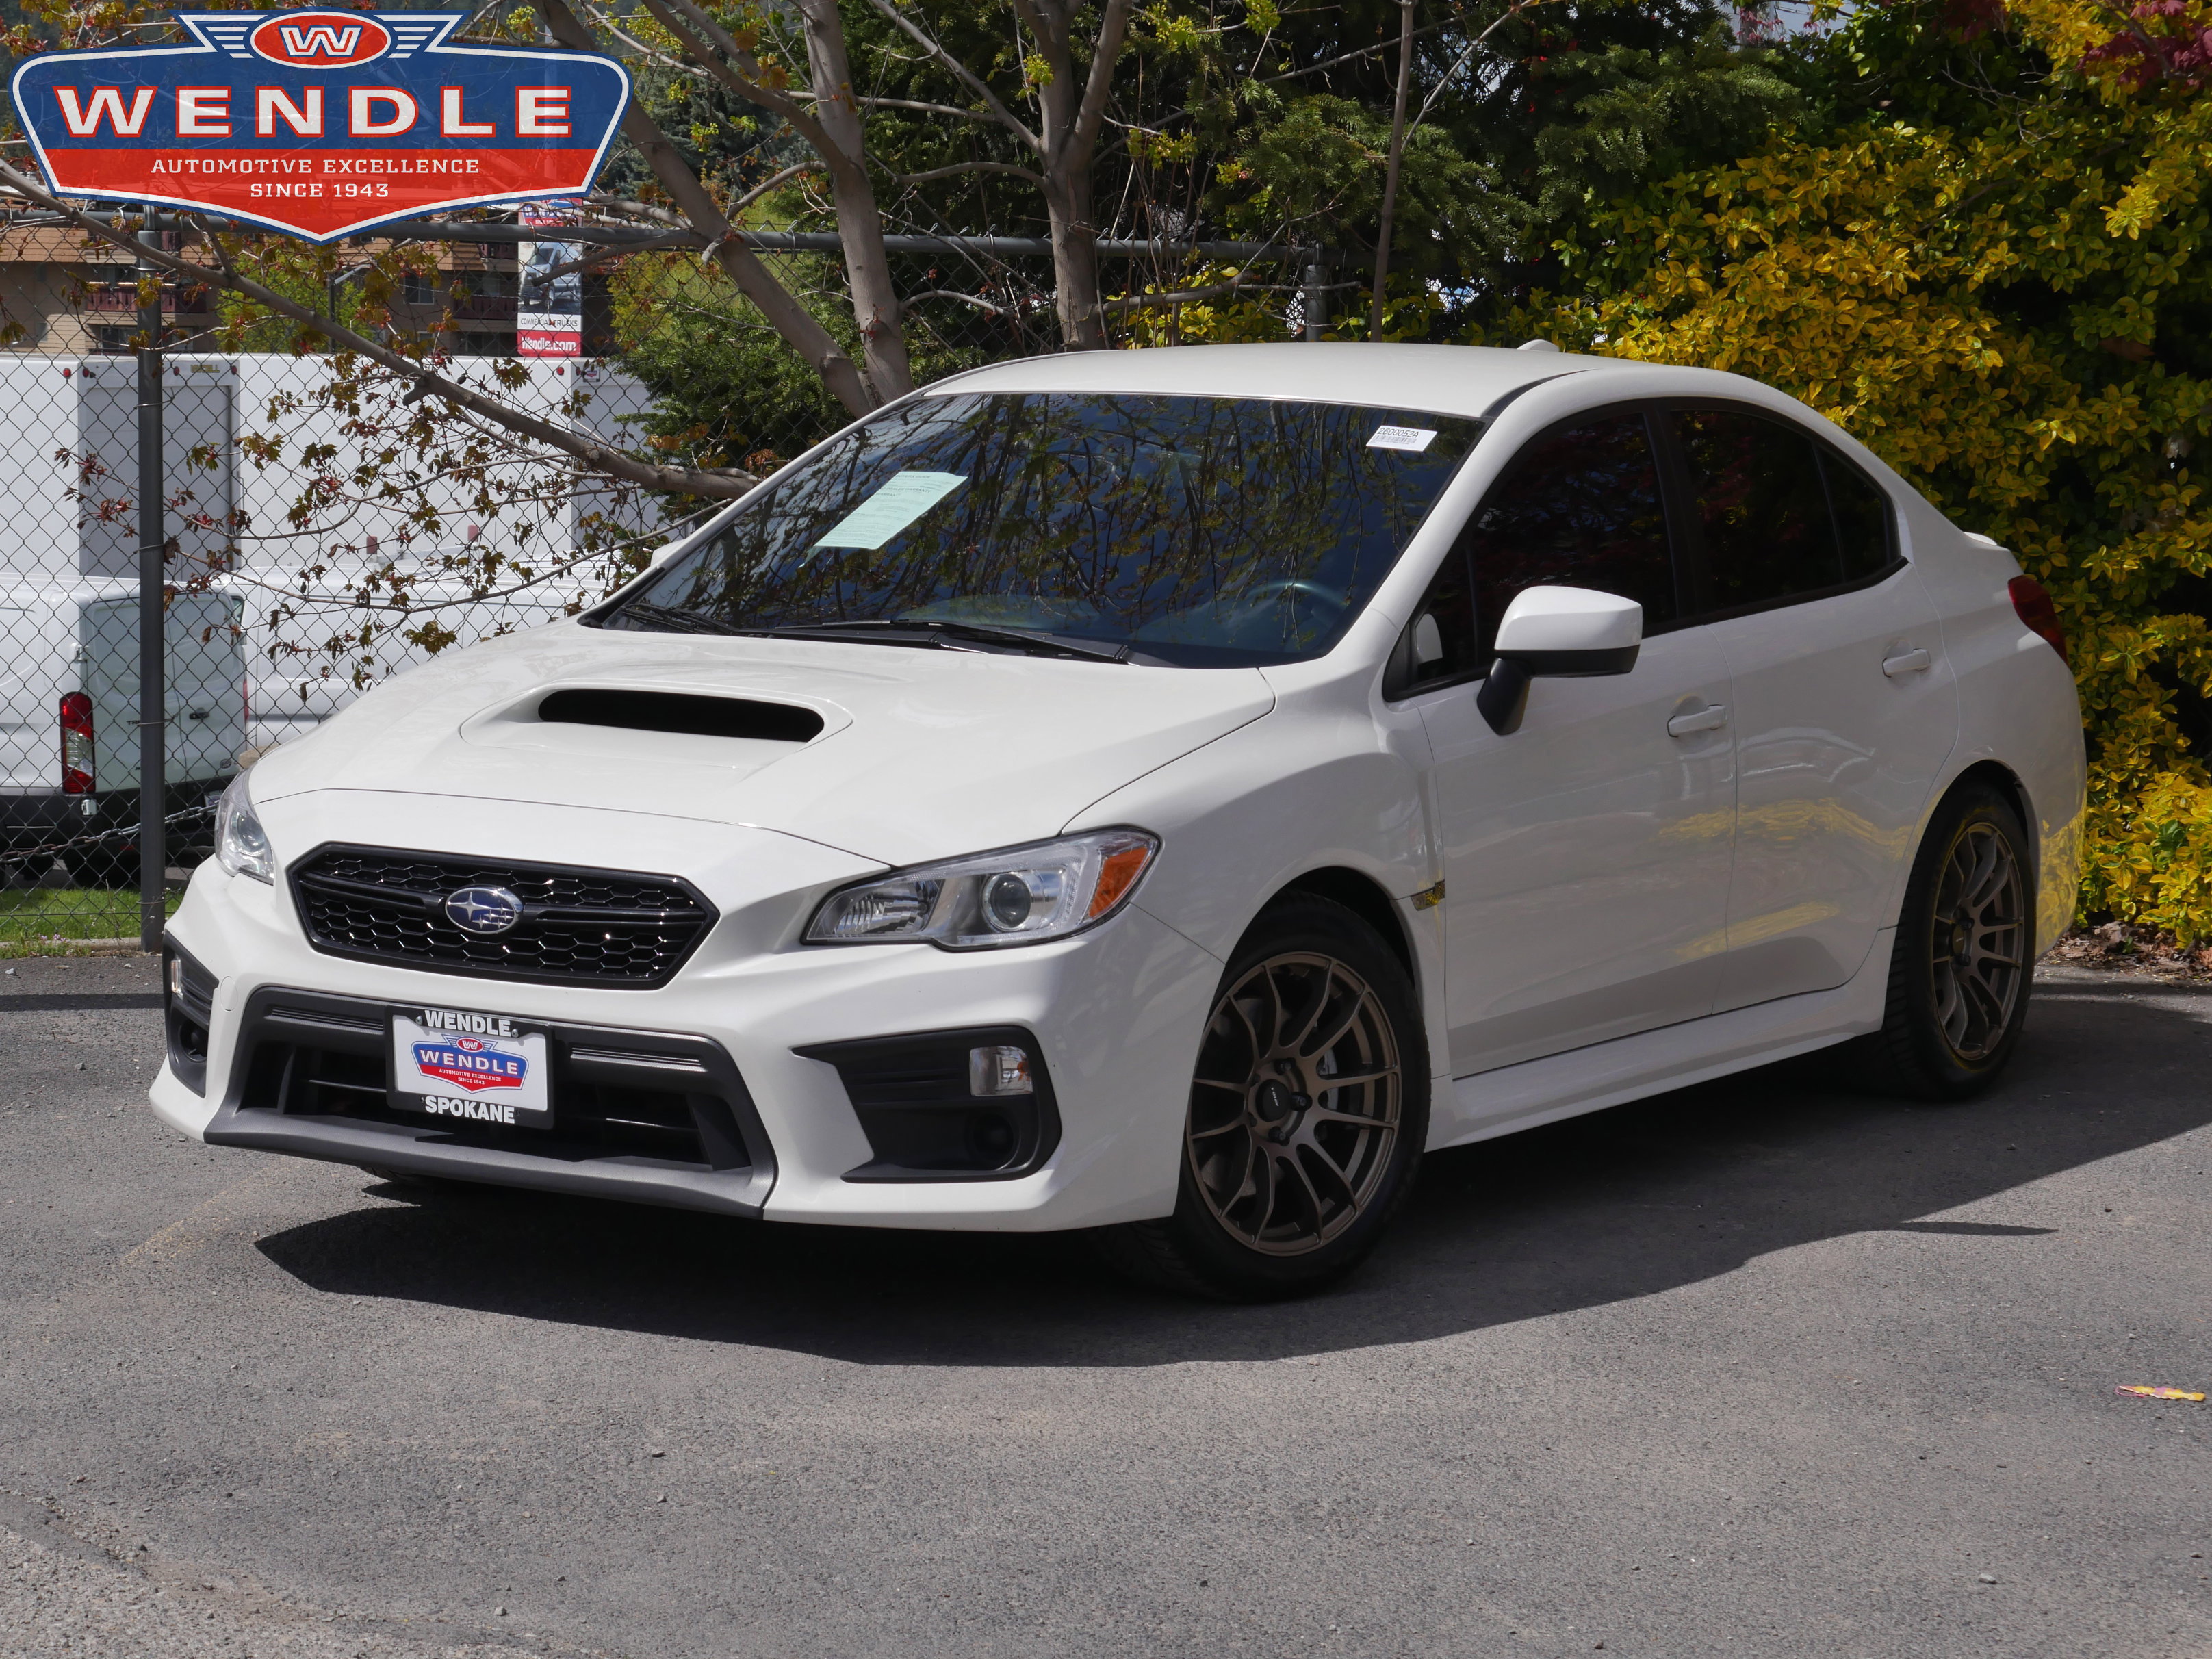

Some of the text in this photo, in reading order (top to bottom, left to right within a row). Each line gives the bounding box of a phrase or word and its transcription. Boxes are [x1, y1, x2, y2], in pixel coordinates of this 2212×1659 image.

[522, 337, 576, 351] Wendle.com
[425, 1010, 511, 1037] WENDLE
[420, 1050, 518, 1075] WENDLE
[439, 1068, 502, 1082] AUTOMOTIVE EXCELLENCE
[425, 1096, 515, 1124] SPOKANE
